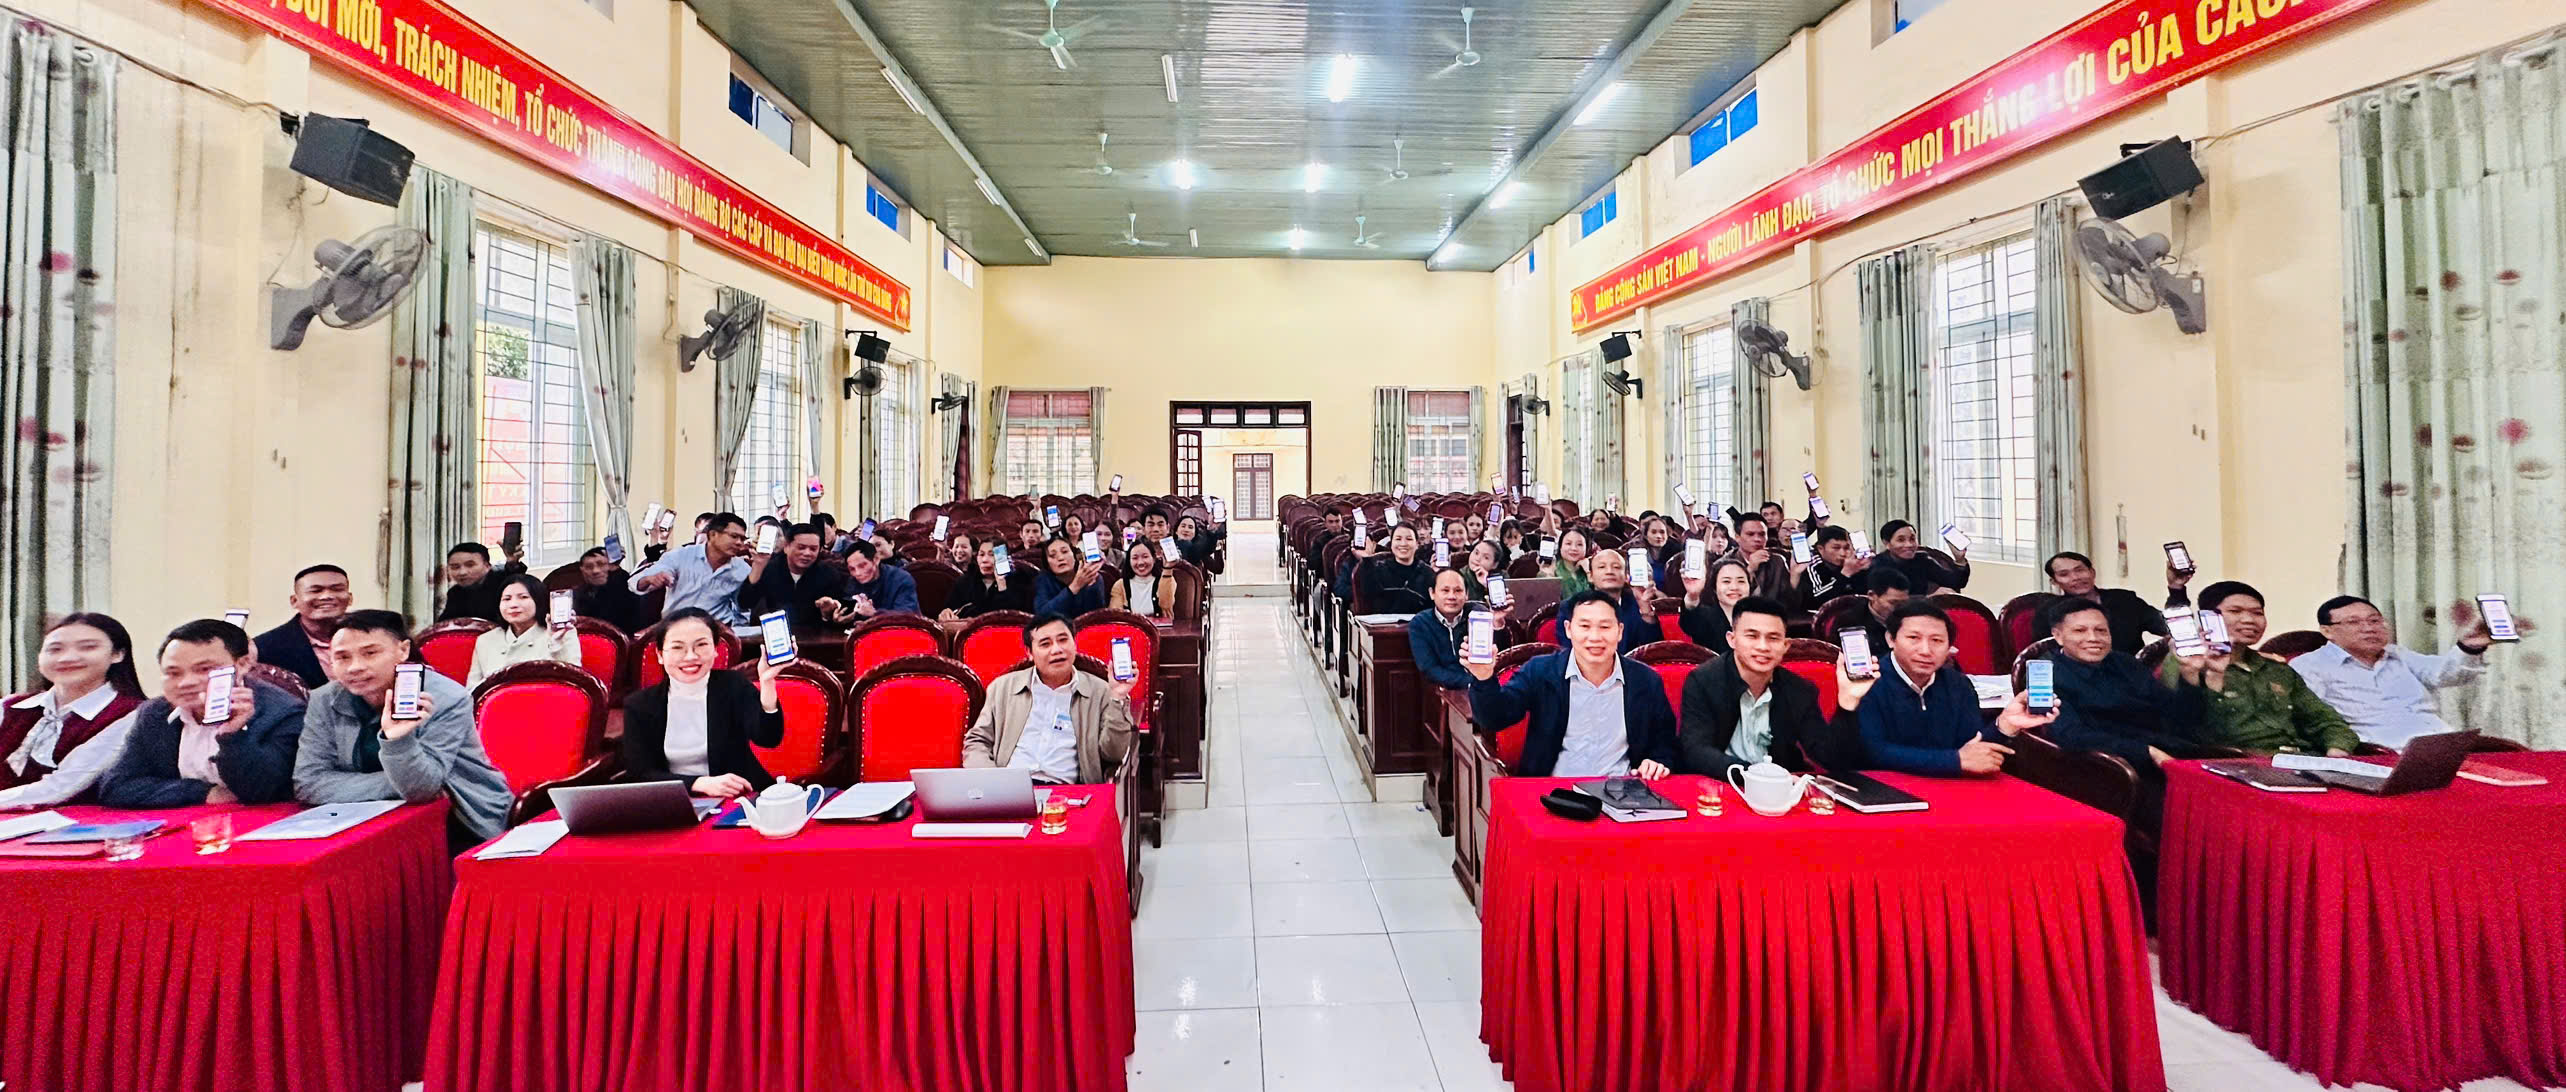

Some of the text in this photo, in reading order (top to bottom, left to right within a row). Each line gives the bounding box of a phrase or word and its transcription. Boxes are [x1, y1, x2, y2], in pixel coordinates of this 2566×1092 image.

[394, 17, 457, 94] TRÁCH
[461, 55, 520, 131] NHIỆM,
[525, 83, 545, 137] TỔ
[546, 104, 583, 157] CHỨC
[626, 146, 657, 195] CÔNG
[658, 166, 676, 210] ĐẠI
[677, 174, 693, 218] HỘI
[694, 179, 718, 227] ĐẢNG
[719, 197, 730, 239] BỘ
[732, 204, 747, 240] CÁC
[748, 210, 763, 248] CẤP
[764, 221, 773, 254] VÀ
[1595, 285, 1614, 313] ĐẢNG
[1615, 278, 1636, 306] CỘNG
[1636, 264, 1654, 295] SẢN
[1655, 256, 1674, 288] VIỆT
[1675, 246, 1699, 279] NAM
[1707, 221, 1742, 264] NGƯỜI
[1745, 207, 1779, 248] LÃNH
[1782, 192, 1816, 232] ĐẠO,
[1821, 164, 1841, 213] TỔ
[1846, 151, 1895, 201] CHỨC
[1901, 128, 1943, 179] MỌI
[1950, 83, 2036, 156] THẮNG
[2047, 53, 2096, 112] LỢI
[2107, 11, 2184, 85] CỦA
